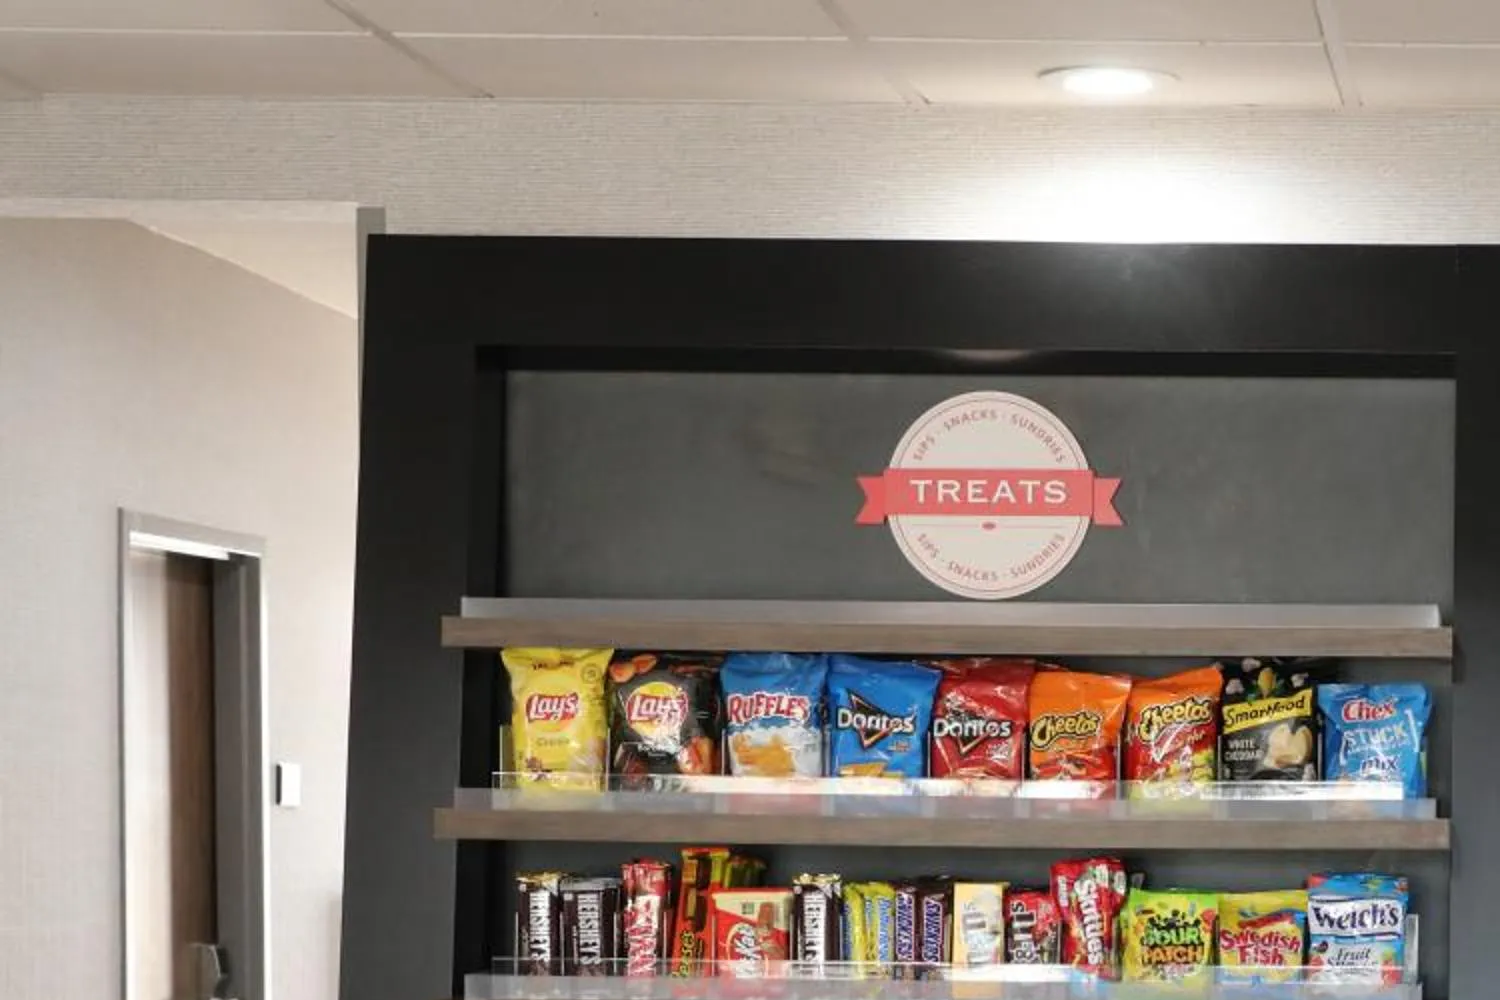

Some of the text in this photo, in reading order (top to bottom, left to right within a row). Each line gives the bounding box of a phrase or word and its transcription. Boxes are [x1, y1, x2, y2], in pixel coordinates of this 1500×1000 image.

[910, 479, 1067, 504] TREATS
[526, 693, 580, 719] Lay's
[628, 690, 689, 723] Lay's
[727, 691, 809, 725] RUFFLES
[1224, 697, 1305, 727] Smartfood
[1342, 698, 1396, 722] Chex
[837, 707, 915, 734] Doritos
[932, 716, 1013, 739] Doritos
[1031, 711, 1101, 748] Cheetos
[1138, 697, 1213, 743] Cheetos
[577, 892, 601, 966] HERSHEY'S
[1311, 904, 1400, 930] Welch's
[1220, 928, 1301, 953] Swedish
[1238, 946, 1285, 965] Fish
